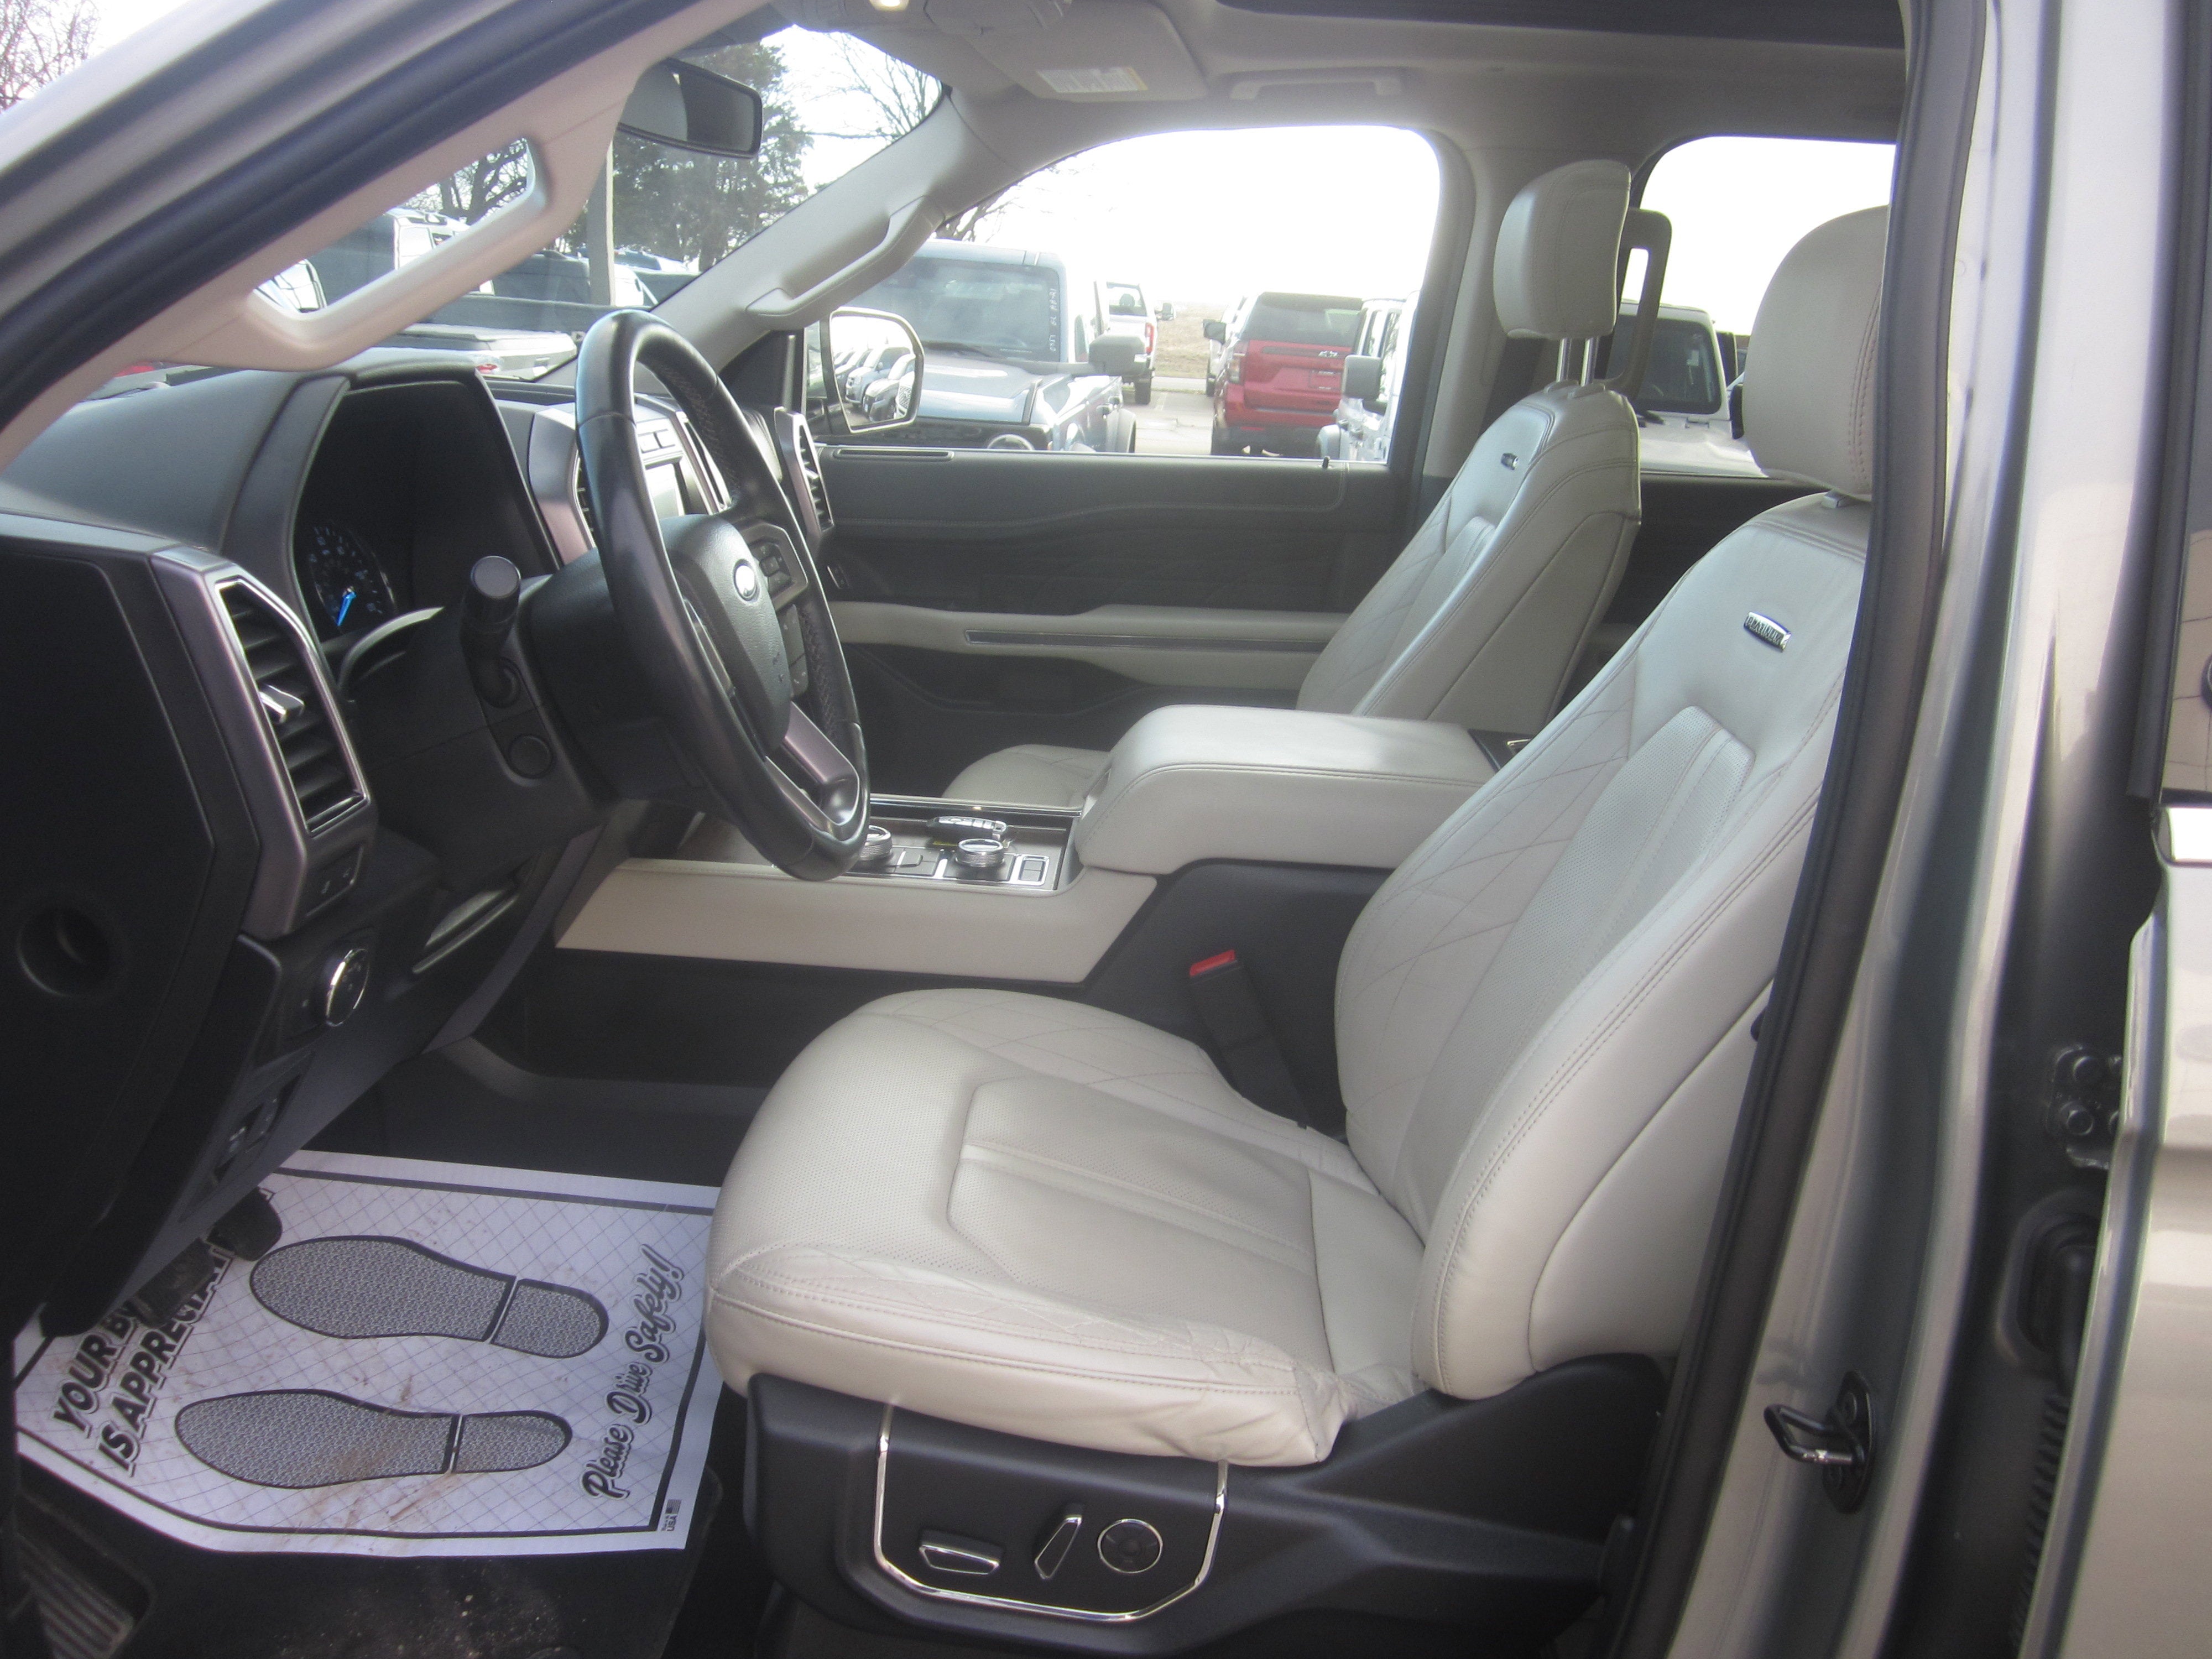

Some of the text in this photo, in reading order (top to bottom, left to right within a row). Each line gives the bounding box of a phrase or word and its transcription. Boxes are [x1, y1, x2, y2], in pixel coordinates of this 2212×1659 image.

[53, 1330, 122, 1439] YOUR
[582, 1244, 685, 1499] Please Drive Safely!
[98, 1422, 141, 1478] IS
